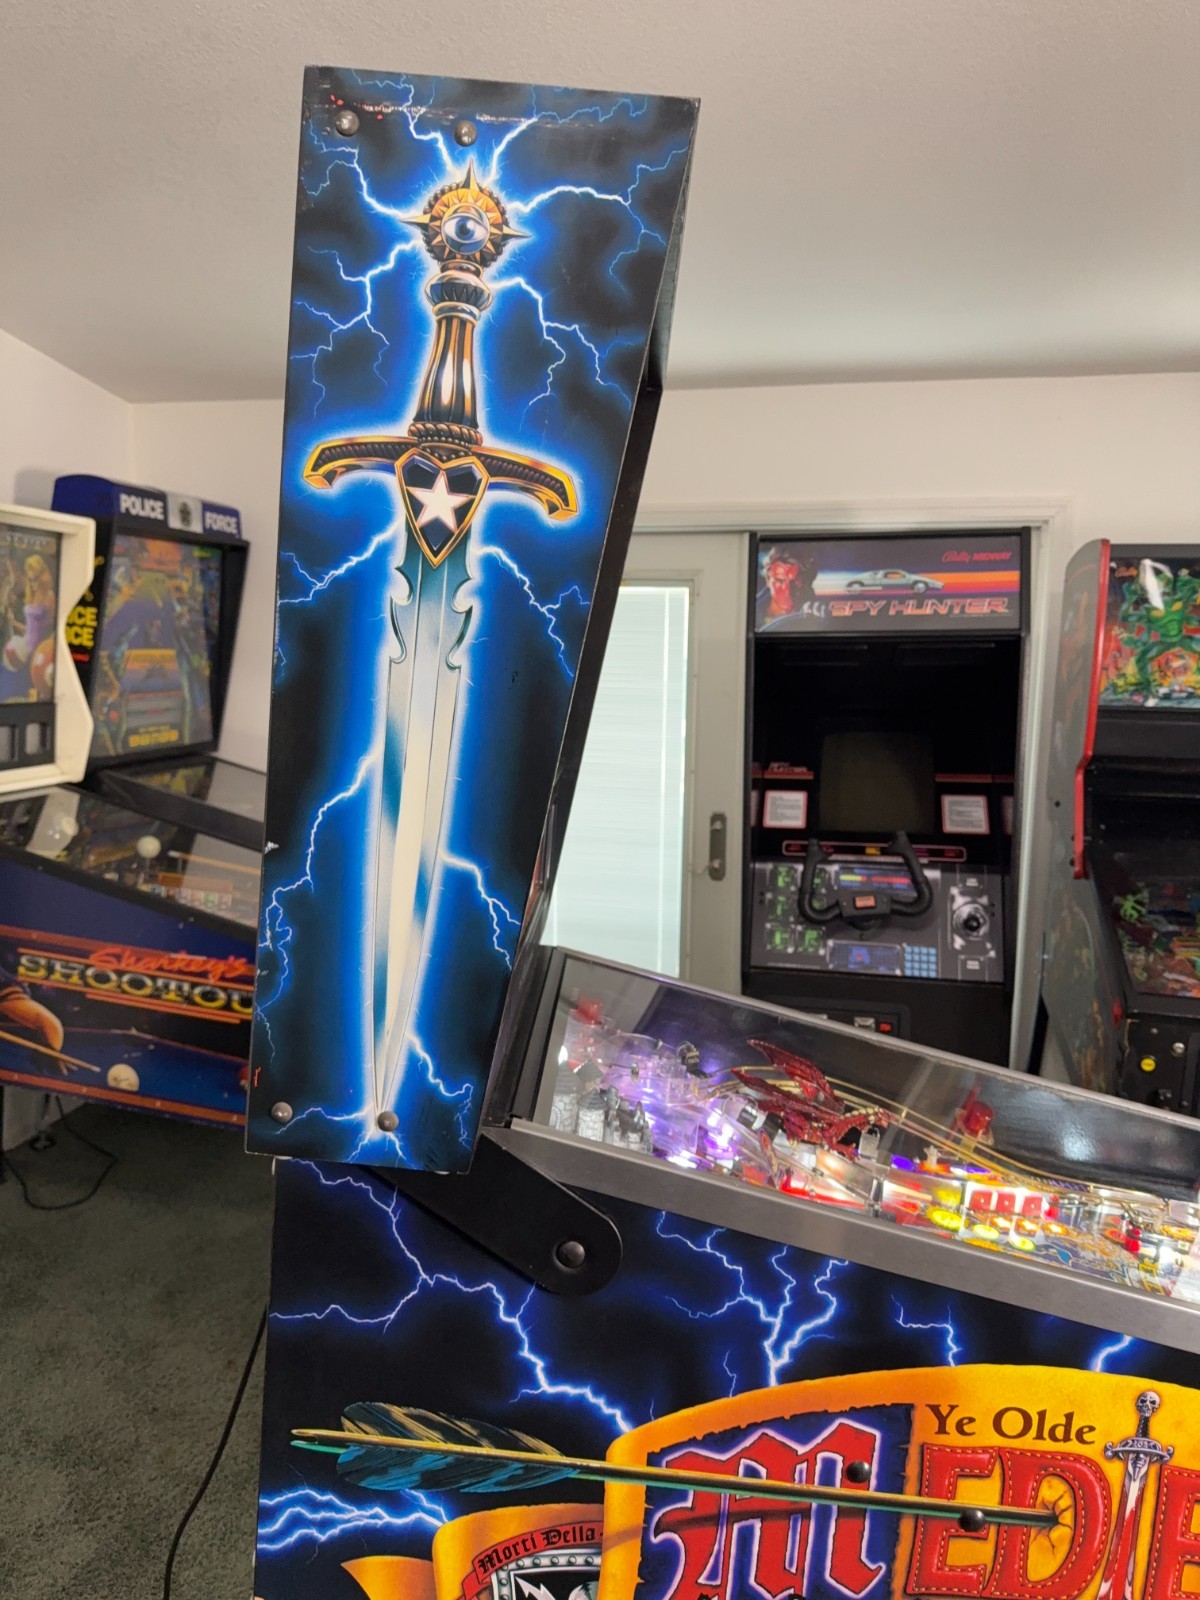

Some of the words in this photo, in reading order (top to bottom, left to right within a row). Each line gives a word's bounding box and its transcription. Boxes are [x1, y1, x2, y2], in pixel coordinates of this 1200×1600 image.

[119, 493, 165, 521] POLICE
[204, 511, 239, 535] FORCE
[828, 600, 887, 617] SPY
[888, 598, 1011, 616] HUNTER
[88, 947, 248, 982] Sharkey's
[925, 1403, 977, 1437] Ye
[991, 1406, 1097, 1446] Olde
[477, 1532, 537, 1574] Morti
[540, 1525, 596, 1547] Della
